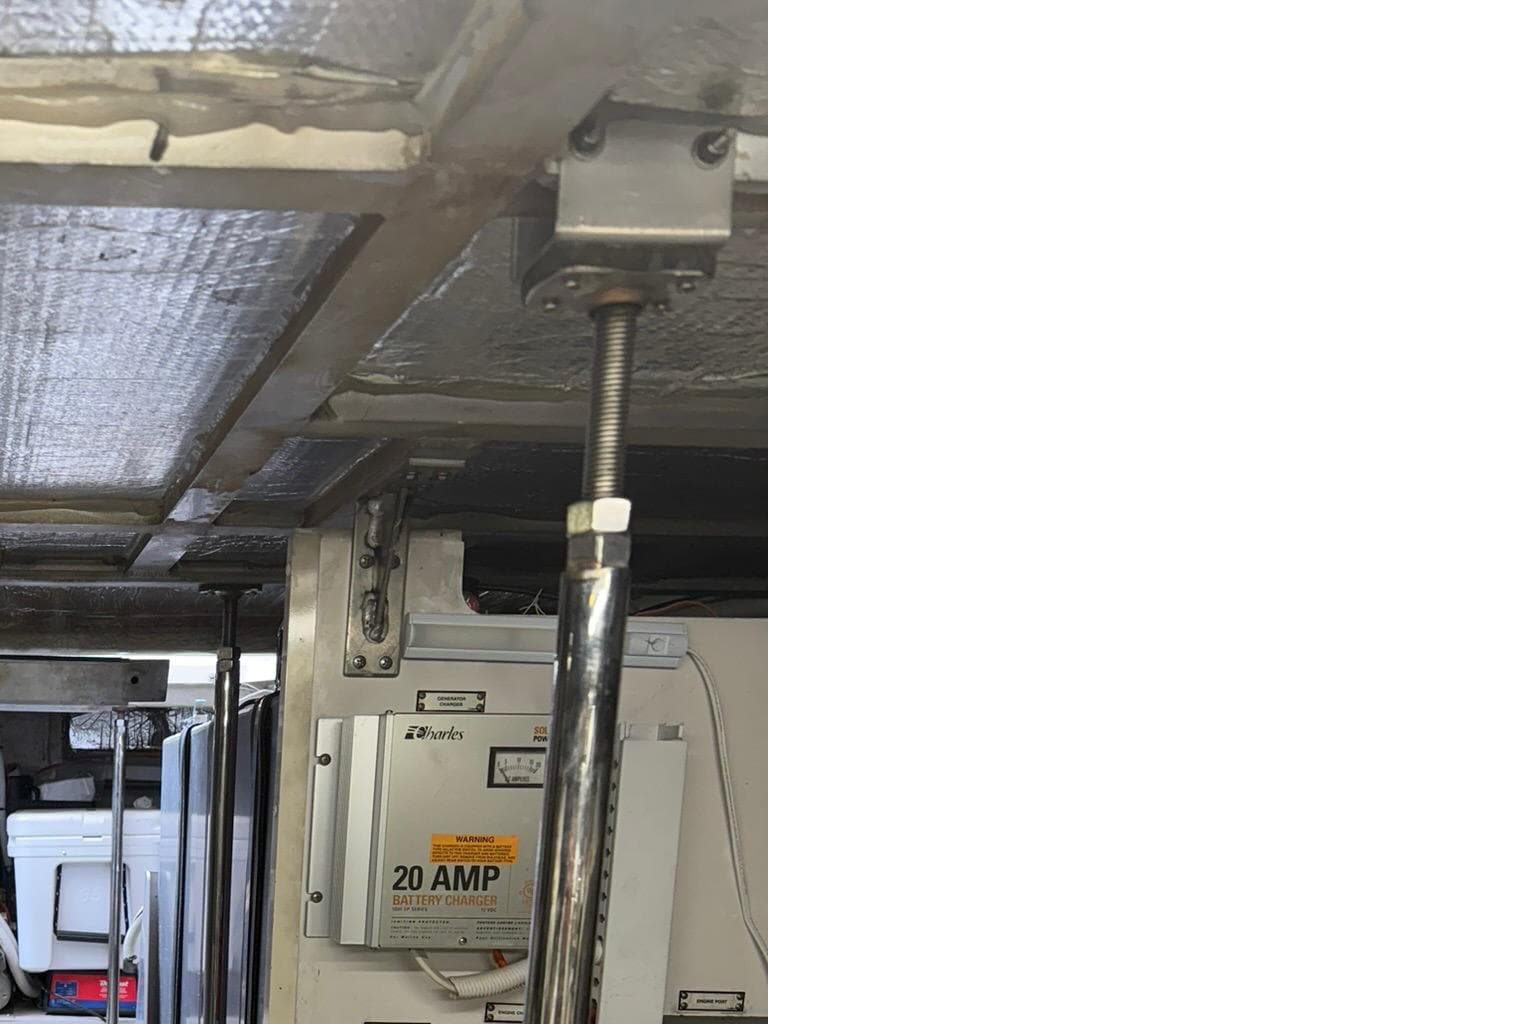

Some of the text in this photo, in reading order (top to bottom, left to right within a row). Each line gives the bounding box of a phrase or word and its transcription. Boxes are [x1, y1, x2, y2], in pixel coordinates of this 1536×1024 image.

[415, 726, 464, 741] Charles
[455, 835, 495, 843] WARNING
[392, 865, 501, 891] 20 AMP
[392, 894, 498, 907] BATTERY CHARGER
